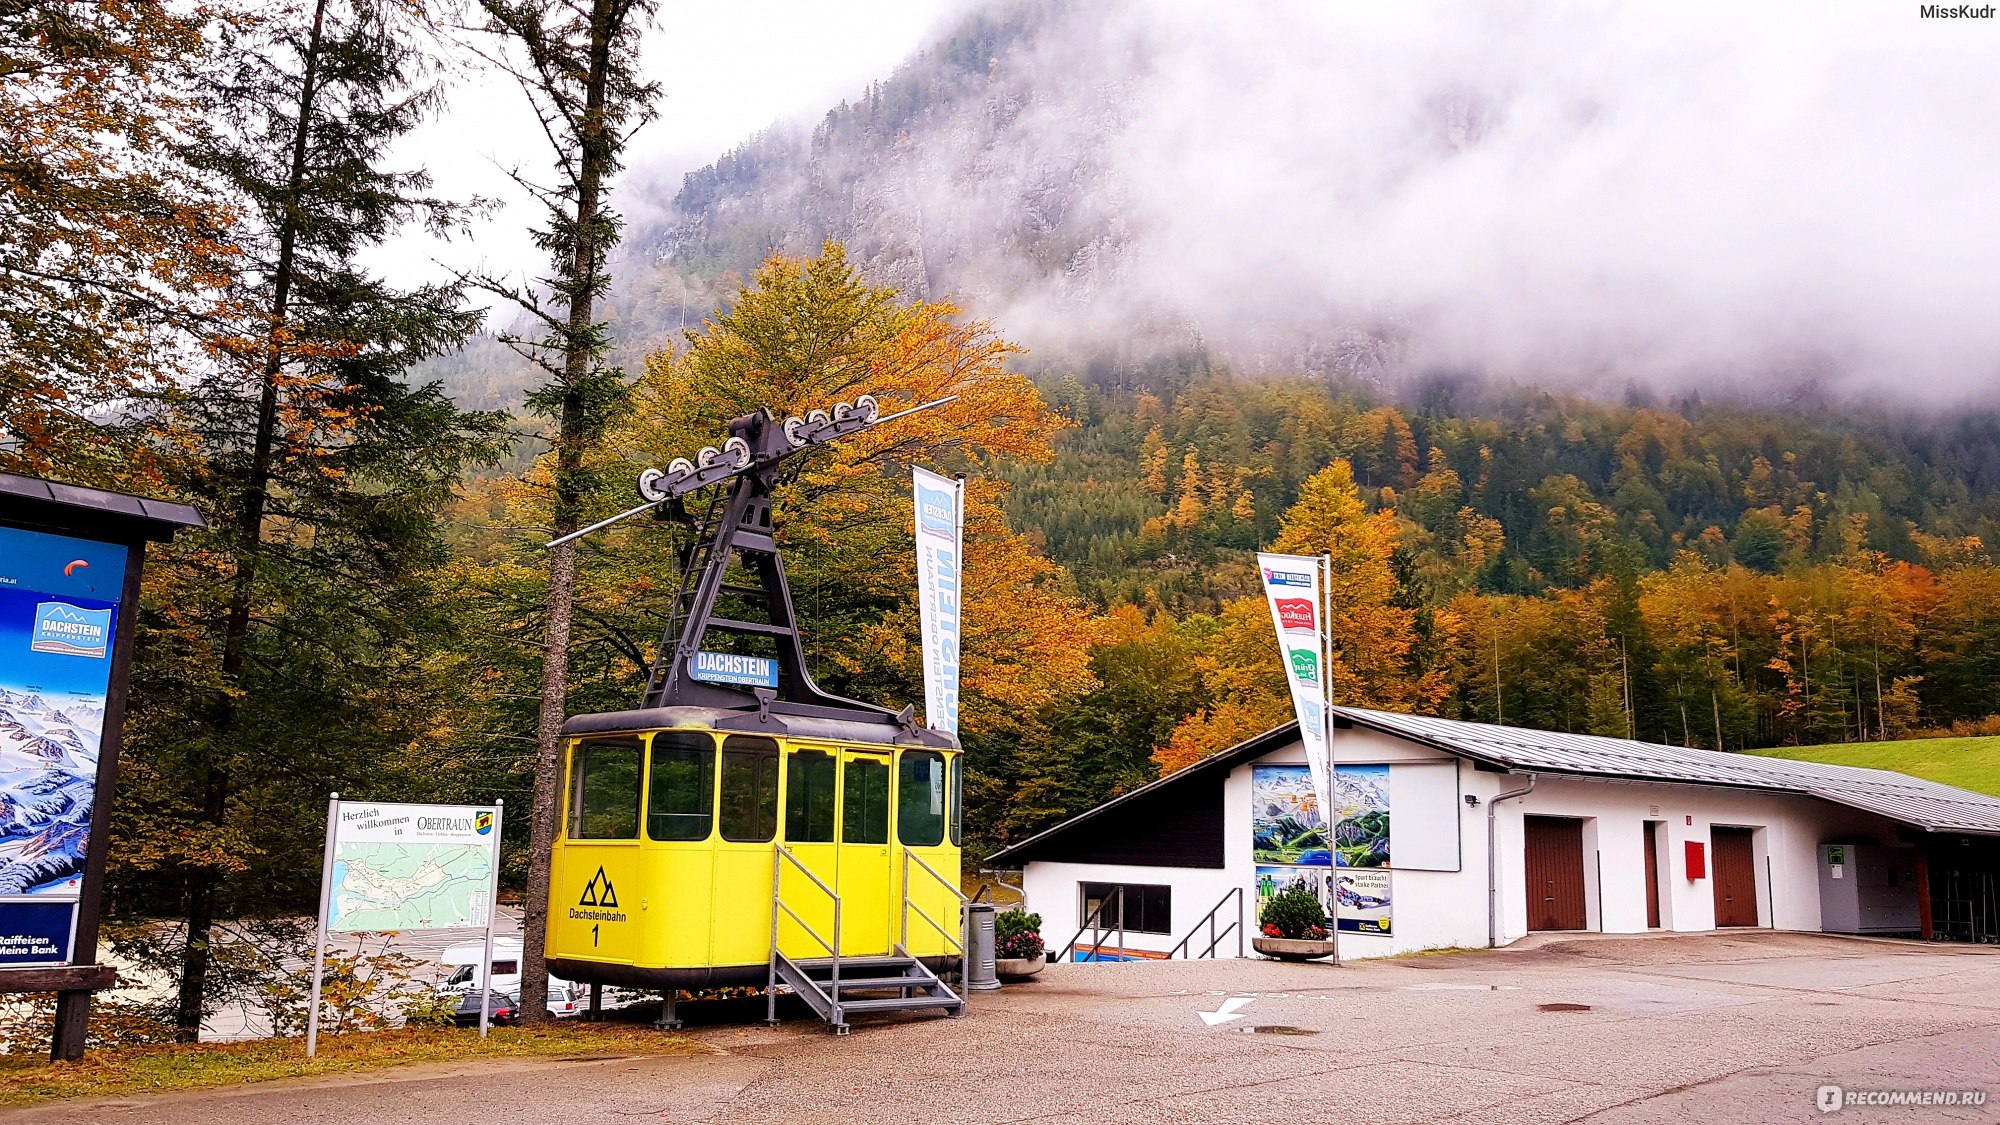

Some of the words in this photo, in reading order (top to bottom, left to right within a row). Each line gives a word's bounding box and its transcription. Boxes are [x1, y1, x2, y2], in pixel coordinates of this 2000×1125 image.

[42, 619, 102, 637] DACHSTEIN
[697, 652, 770, 677] DACHSTEIN
[697, 671, 737, 683] KRIPPENSTEIN
[738, 676, 770, 686] OBERTRAUN
[342, 808, 380, 822] Herzlich
[356, 816, 410, 831] willkommen
[417, 816, 472, 831] OBERTRAUN
[394, 827, 403, 836] in
[569, 907, 627, 922] Dachsteinbahn
[591, 923, 599, 948] 1
[31, 944, 58, 954] Bank
